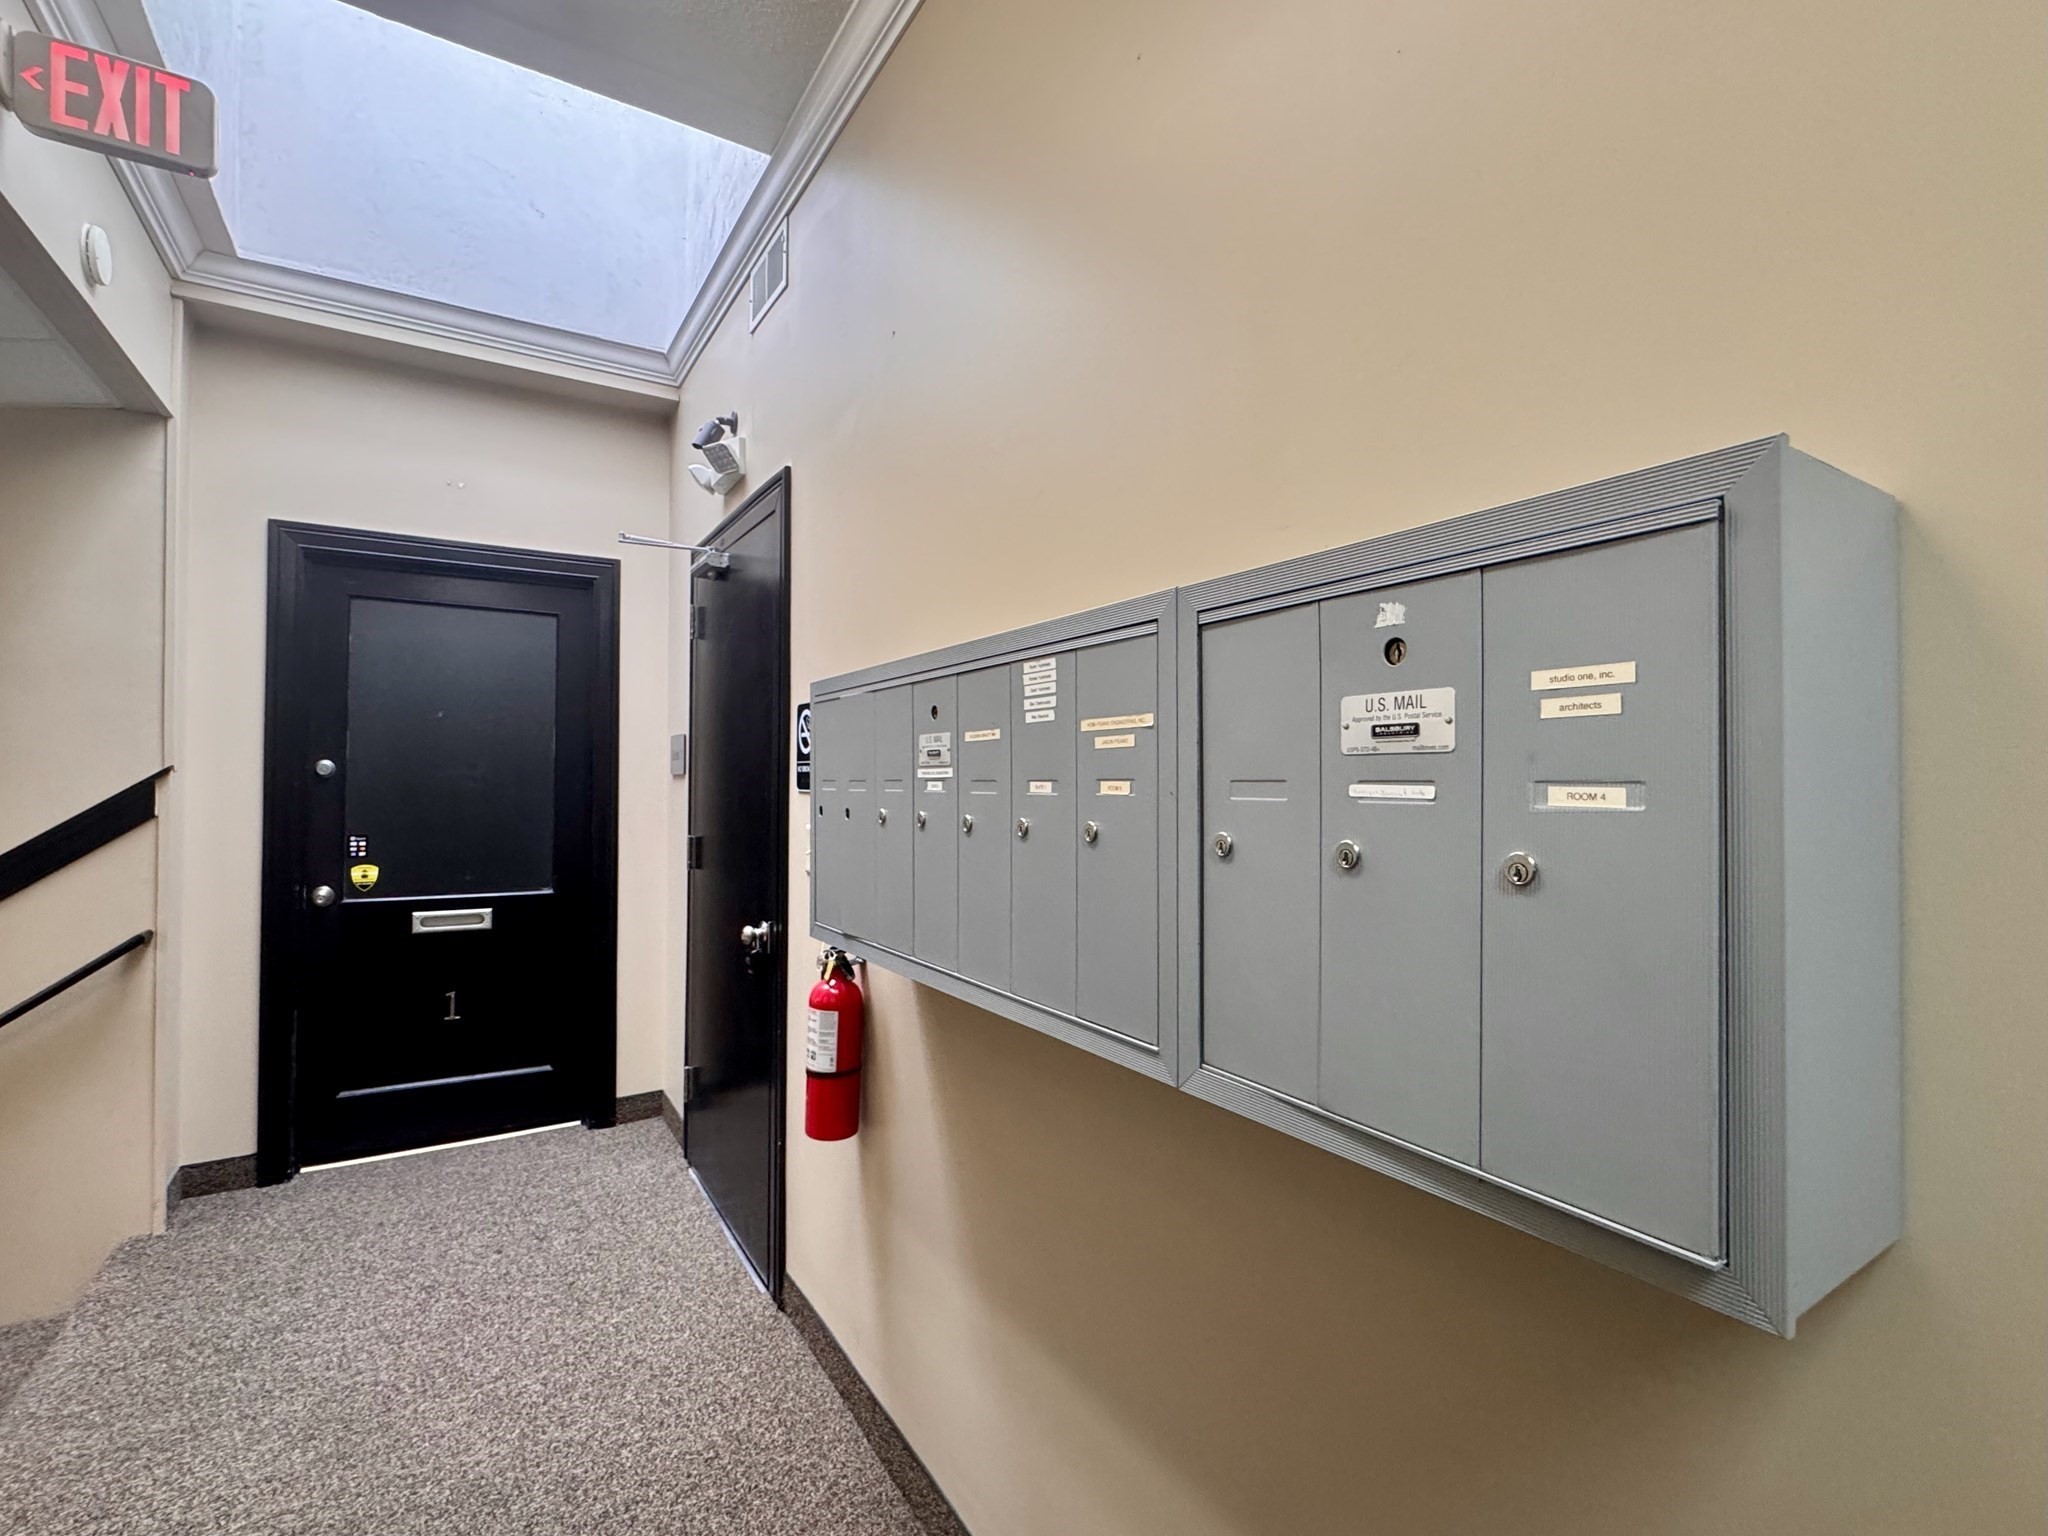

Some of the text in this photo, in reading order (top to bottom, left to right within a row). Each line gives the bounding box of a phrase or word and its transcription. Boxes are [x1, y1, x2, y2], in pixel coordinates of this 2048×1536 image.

[50, 41, 191, 156] EXIT
[1549, 671, 1615, 684] studio one, inc.
[1365, 694, 1427, 713] U.S. MAIL
[1559, 701, 1602, 712] architects
[1352, 716, 1375, 724] Approved
[1375, 714, 1383, 722] by
[1404, 712, 1420, 720] Postal
[1422, 711, 1442, 719] Service
[1567, 792, 1606, 801] ROOM 4
[444, 991, 461, 1020] 1
